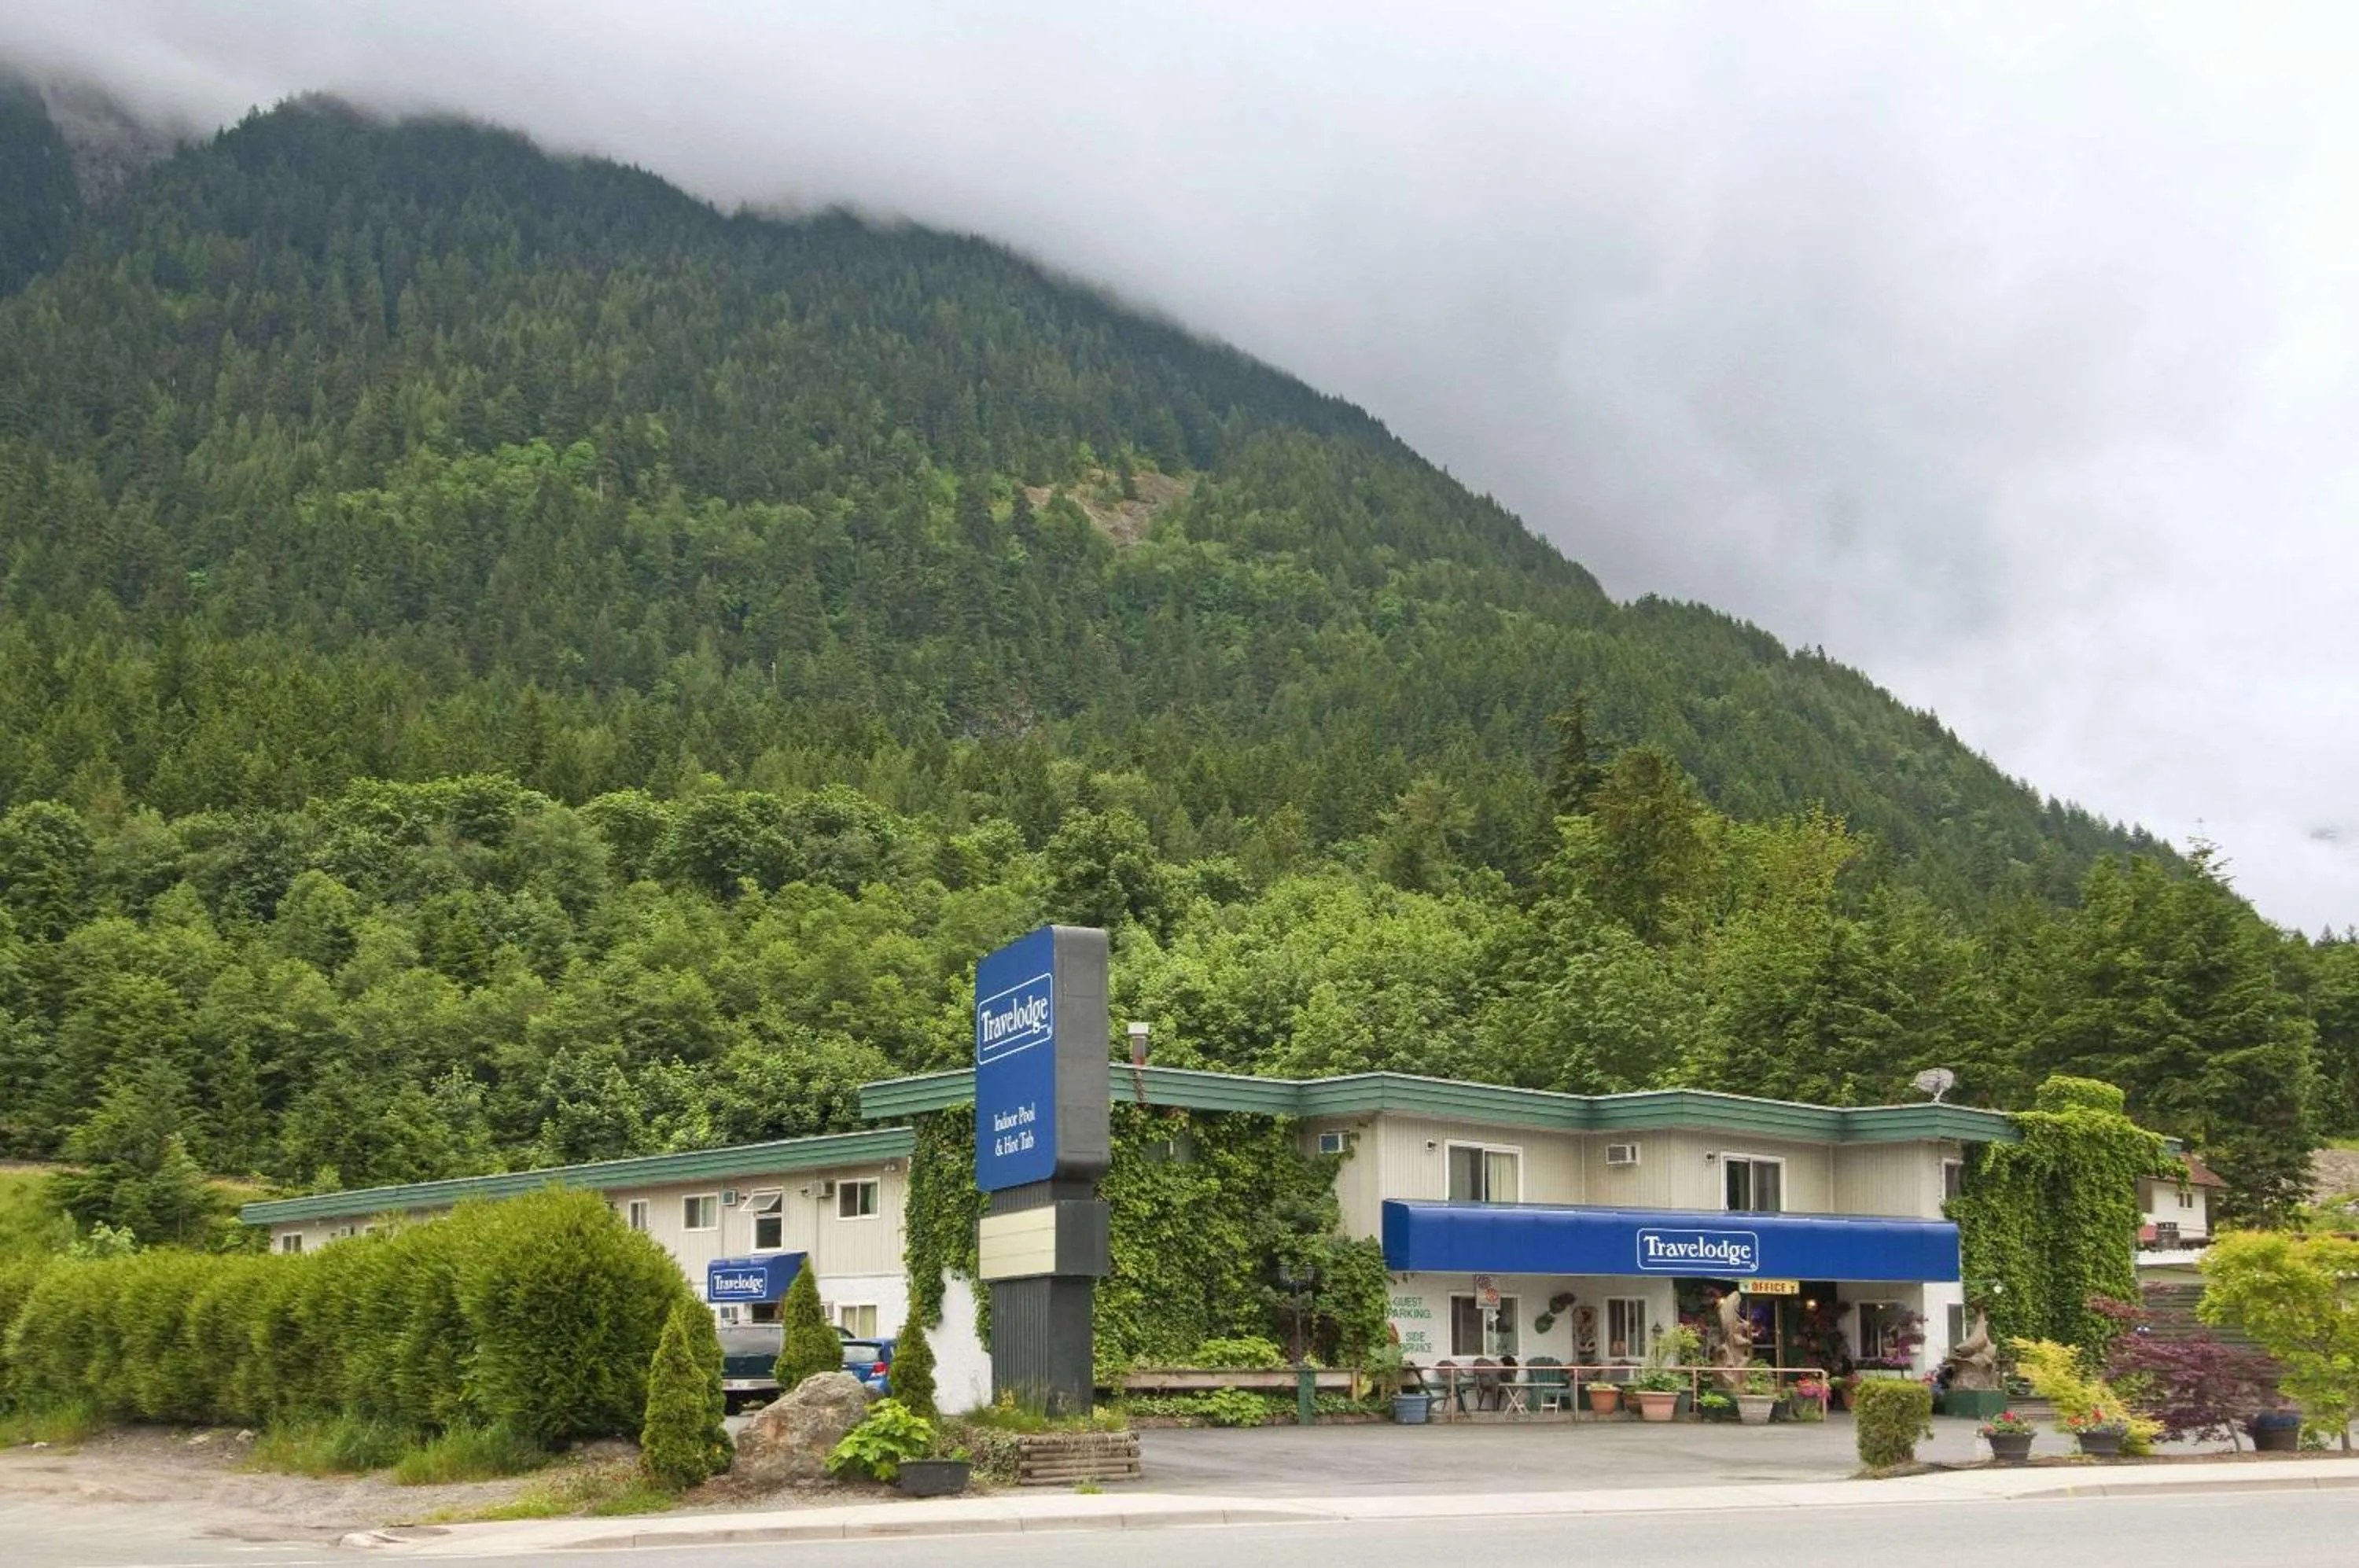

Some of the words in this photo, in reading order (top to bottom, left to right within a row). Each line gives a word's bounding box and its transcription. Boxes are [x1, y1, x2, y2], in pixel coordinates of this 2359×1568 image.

[981, 995, 1048, 1042] Travelodge
[994, 1110, 1018, 1131] Indoor
[1018, 1101, 1036, 1124] Pool
[995, 1139, 1003, 1156] &
[1004, 1135, 1018, 1154] Hot
[1019, 1129, 1034, 1150] Tub
[1643, 1235, 1752, 1264] Travelodge
[713, 1273, 764, 1294] Travelodge
[1751, 1281, 1787, 1292] OFFICE
[1405, 1331, 1426, 1342] SIDE
